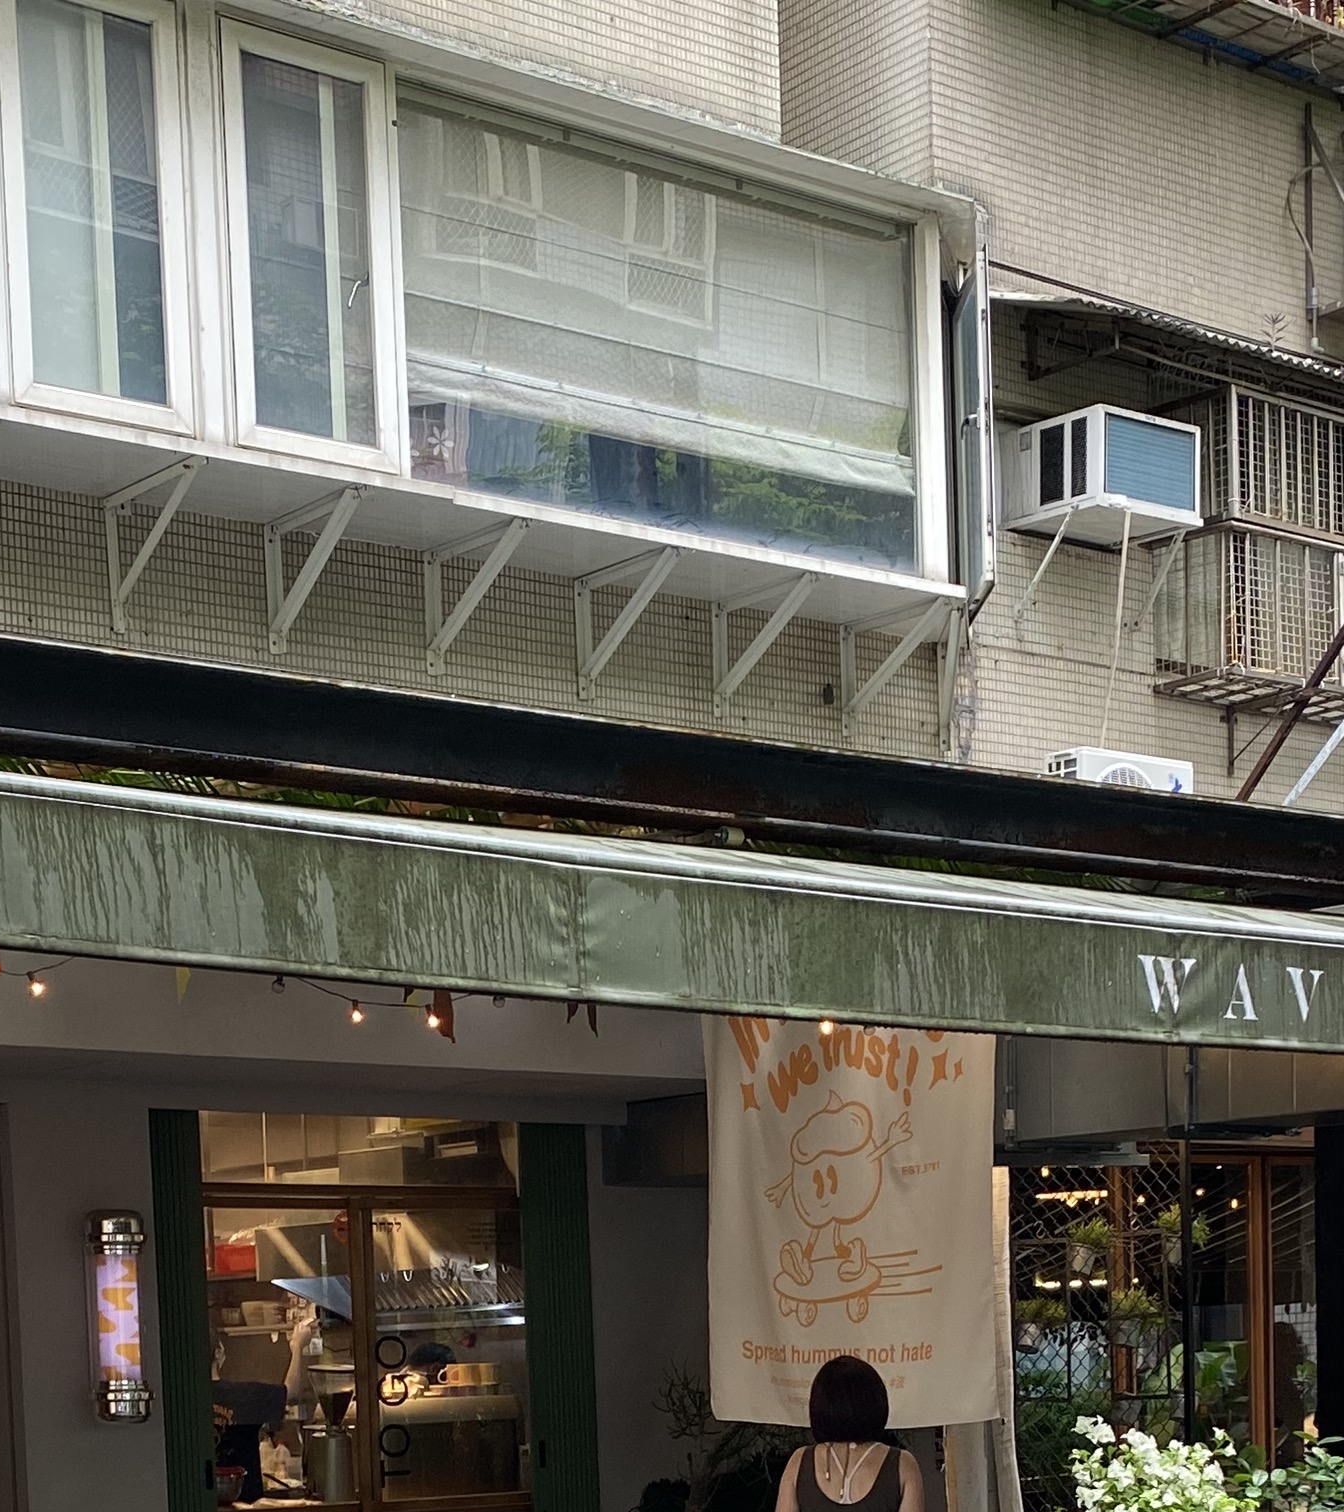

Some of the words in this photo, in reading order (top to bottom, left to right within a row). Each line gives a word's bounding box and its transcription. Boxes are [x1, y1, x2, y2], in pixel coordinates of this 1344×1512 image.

[818, 1026, 919, 1107] trust!
[374, 1335, 409, 1407] GO
[741, 1339, 787, 1365] Spread
[867, 1344, 896, 1364] not
[901, 1342, 933, 1363] hate
[379, 1423, 412, 1489] TO
